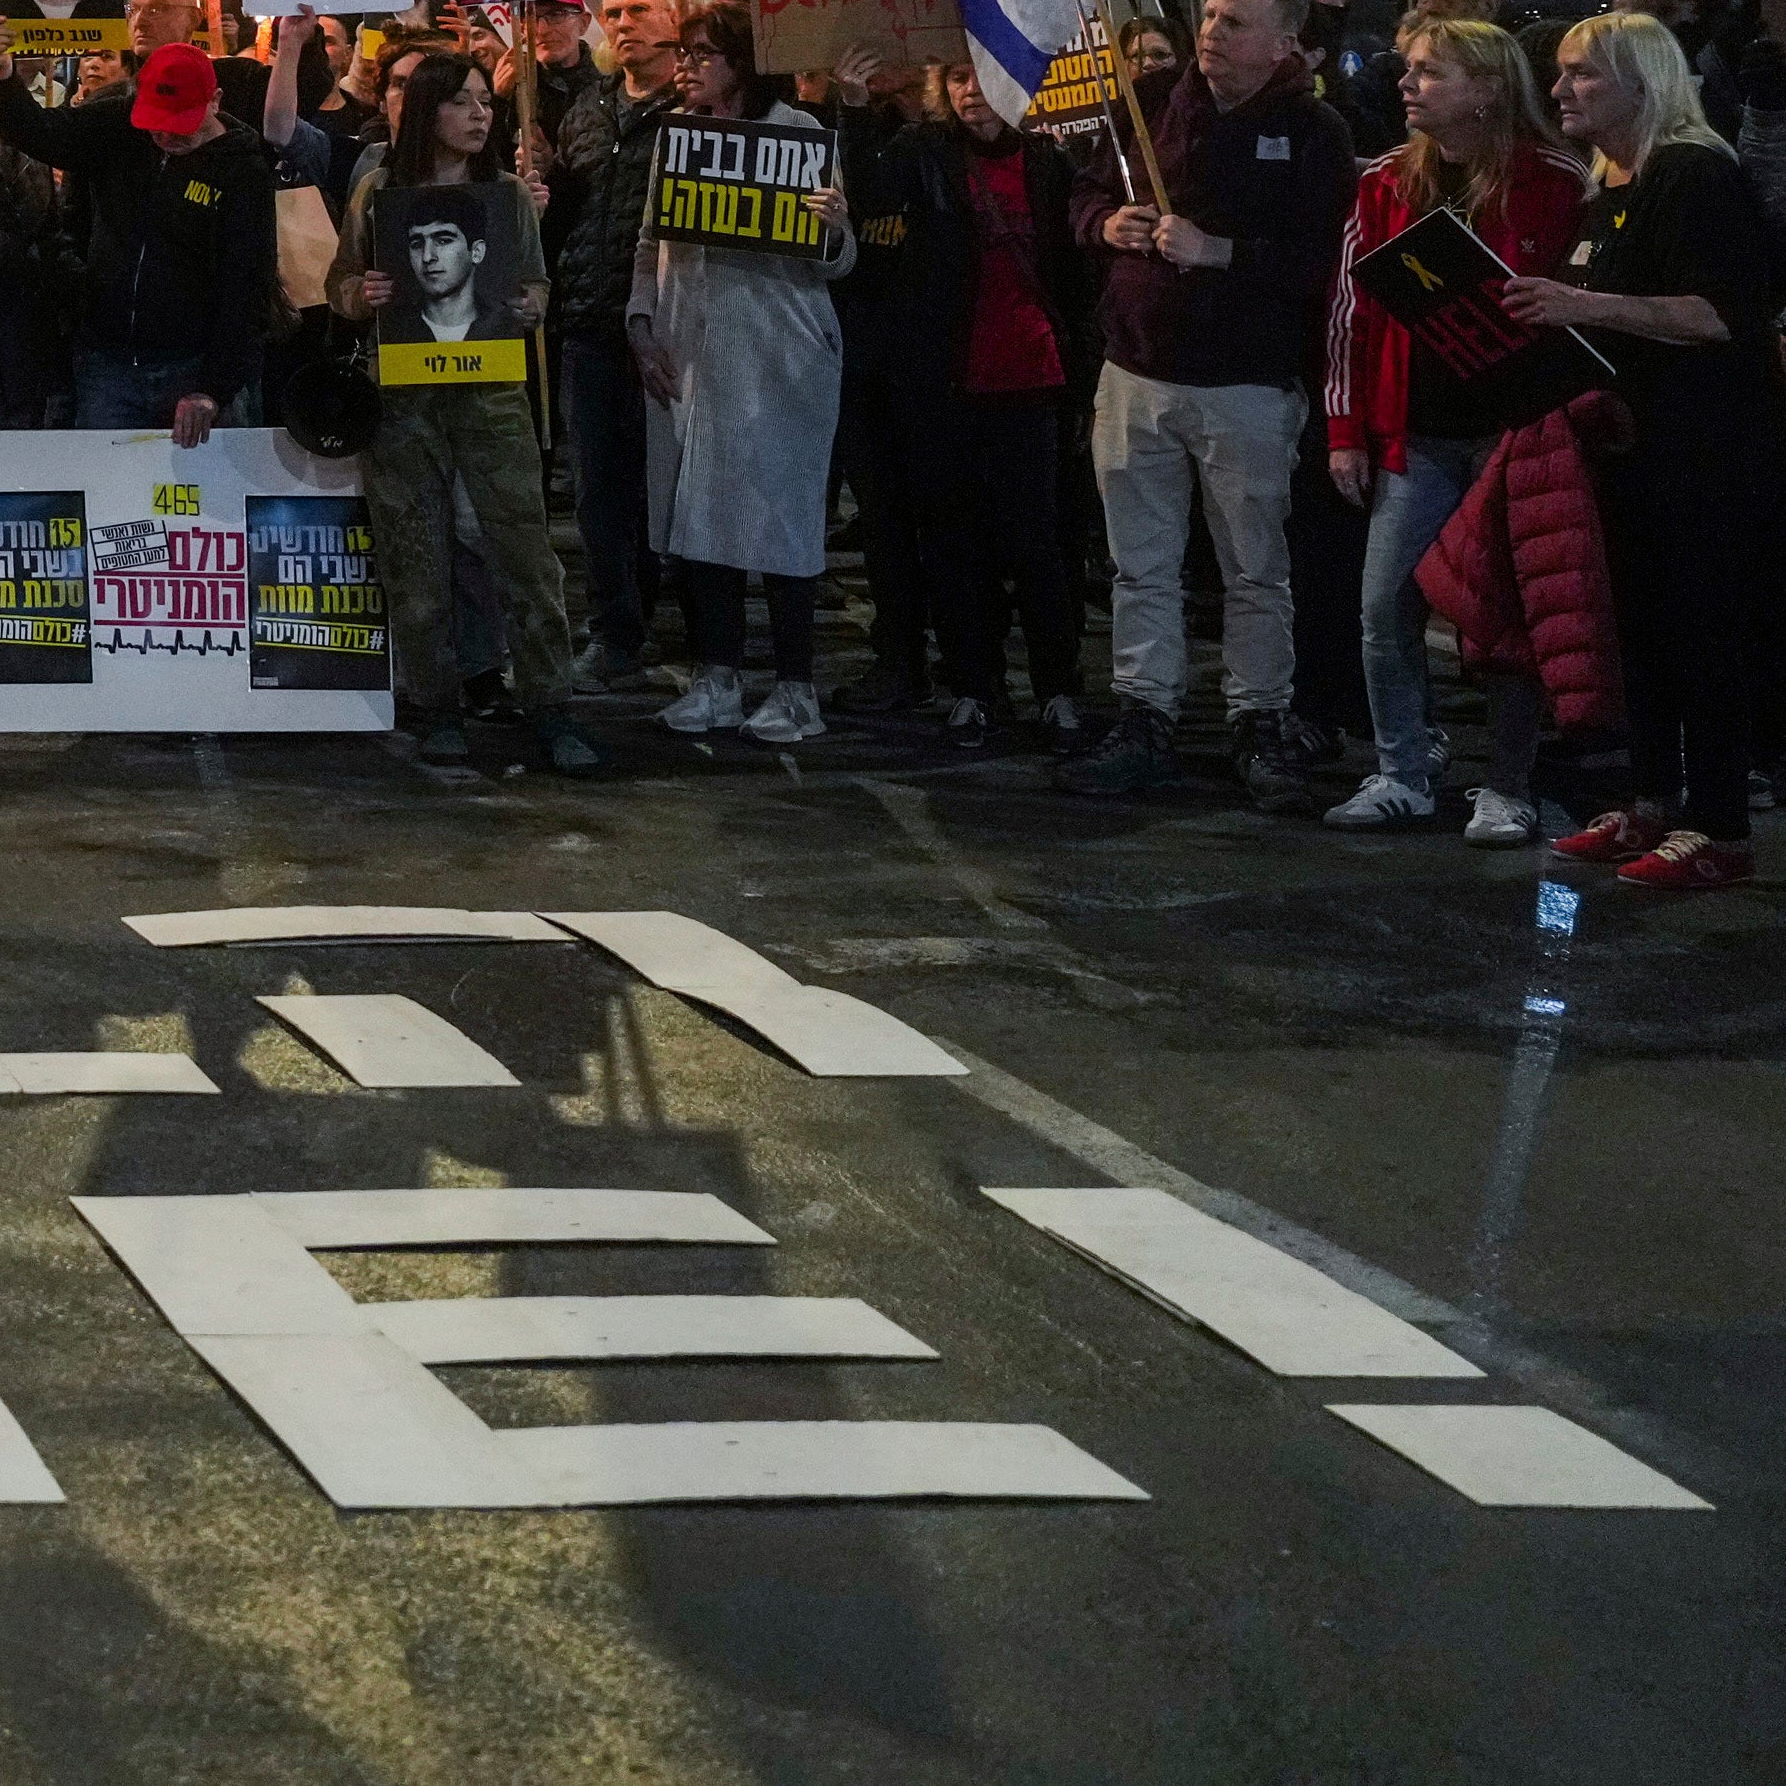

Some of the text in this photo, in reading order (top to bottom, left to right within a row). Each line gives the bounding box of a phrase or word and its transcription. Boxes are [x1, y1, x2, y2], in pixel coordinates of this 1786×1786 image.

[23, 26, 103, 45] שגב כלפון
[664, 126, 827, 190] אתם בבית
[659, 176, 763, 240] בעזה!
[771, 190, 821, 247] הם
[424, 353, 483, 373] אור לוי
[154, 484, 200, 516] 465
[50, 519, 78, 549] 15
[101, 521, 156, 539] נשות ואנשי
[114, 538, 147, 552] בריאות
[21, 549, 85, 579] בשבי
[100, 546, 167, 570] למען החטופים
[168, 526, 245, 572] כולם
[277, 555, 313, 584] הם
[22, 579, 85, 609] סכנת
[93, 577, 245, 621] הומניטרי
[257, 585, 315, 614] מוות
[255, 620, 385, 651] #כולםהומניטרי
